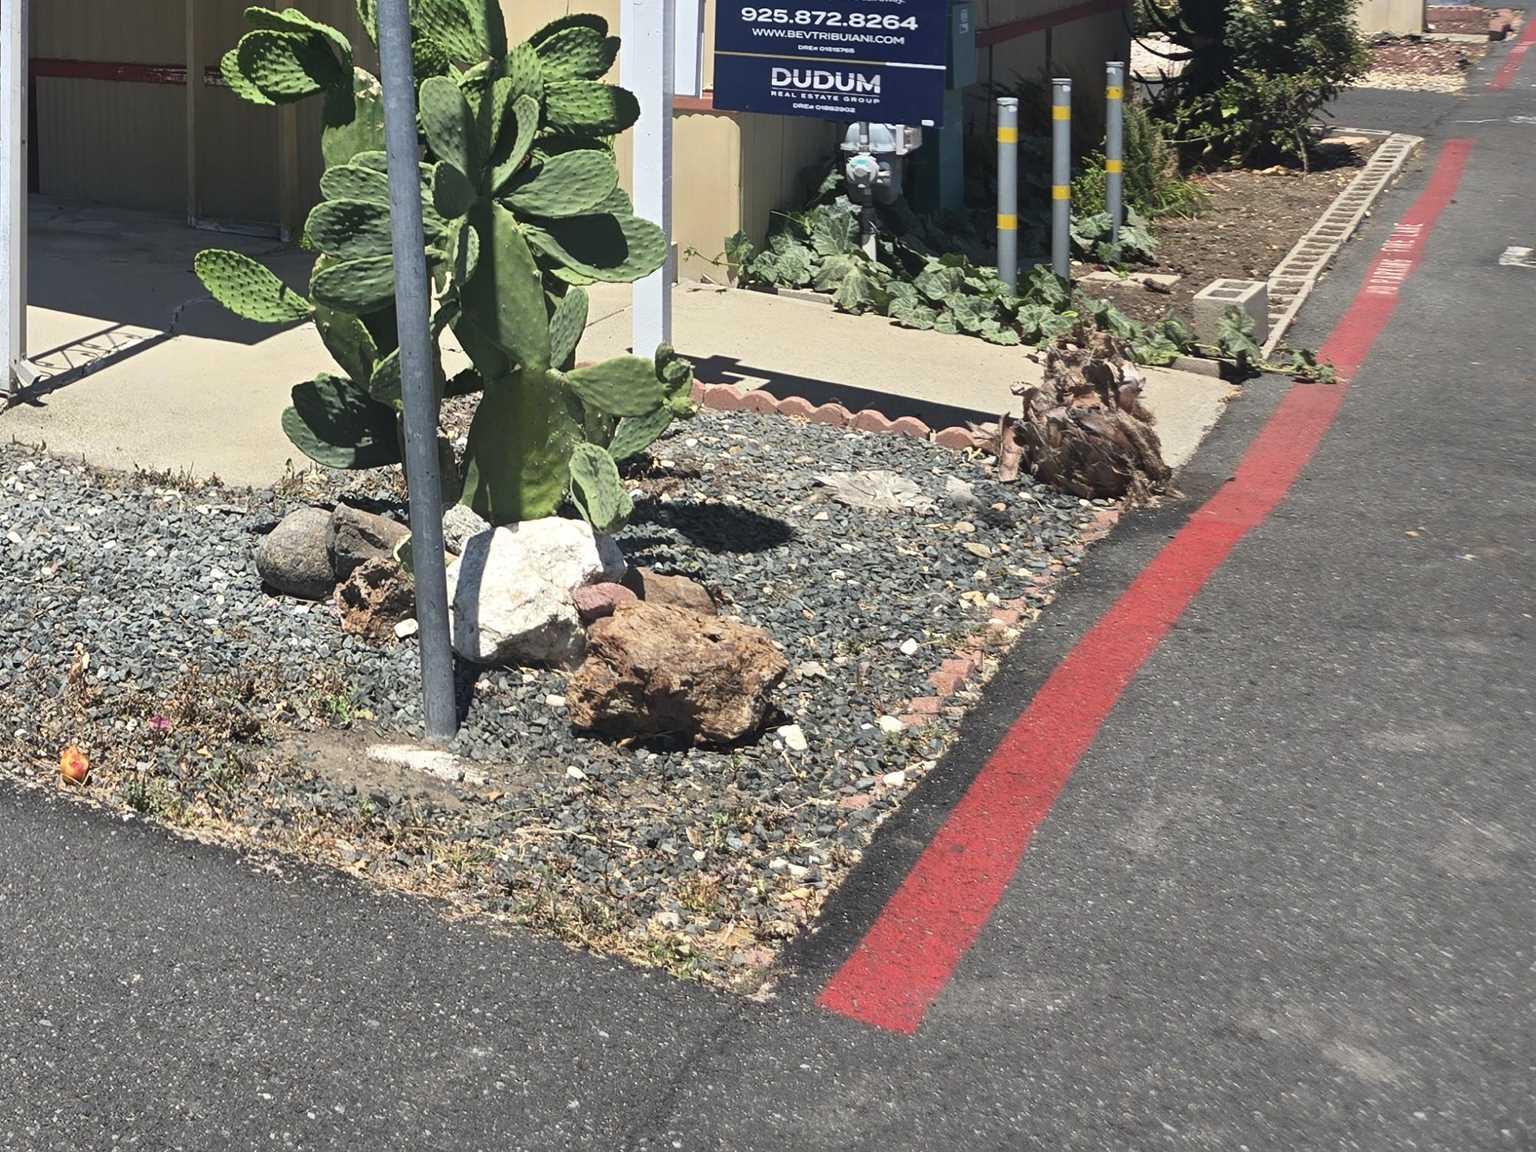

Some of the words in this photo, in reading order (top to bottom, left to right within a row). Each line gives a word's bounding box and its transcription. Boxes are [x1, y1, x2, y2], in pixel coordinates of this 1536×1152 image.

[741, 7, 919, 31] 925.872.8264
[752, 28, 906, 45] WWW.BEVTRIBUIANI.COM
[771, 67, 881, 94] DUDUM
[770, 90, 797, 98] REAL
[800, 93, 839, 102] ESTATE
[843, 96, 881, 104] GROUP
